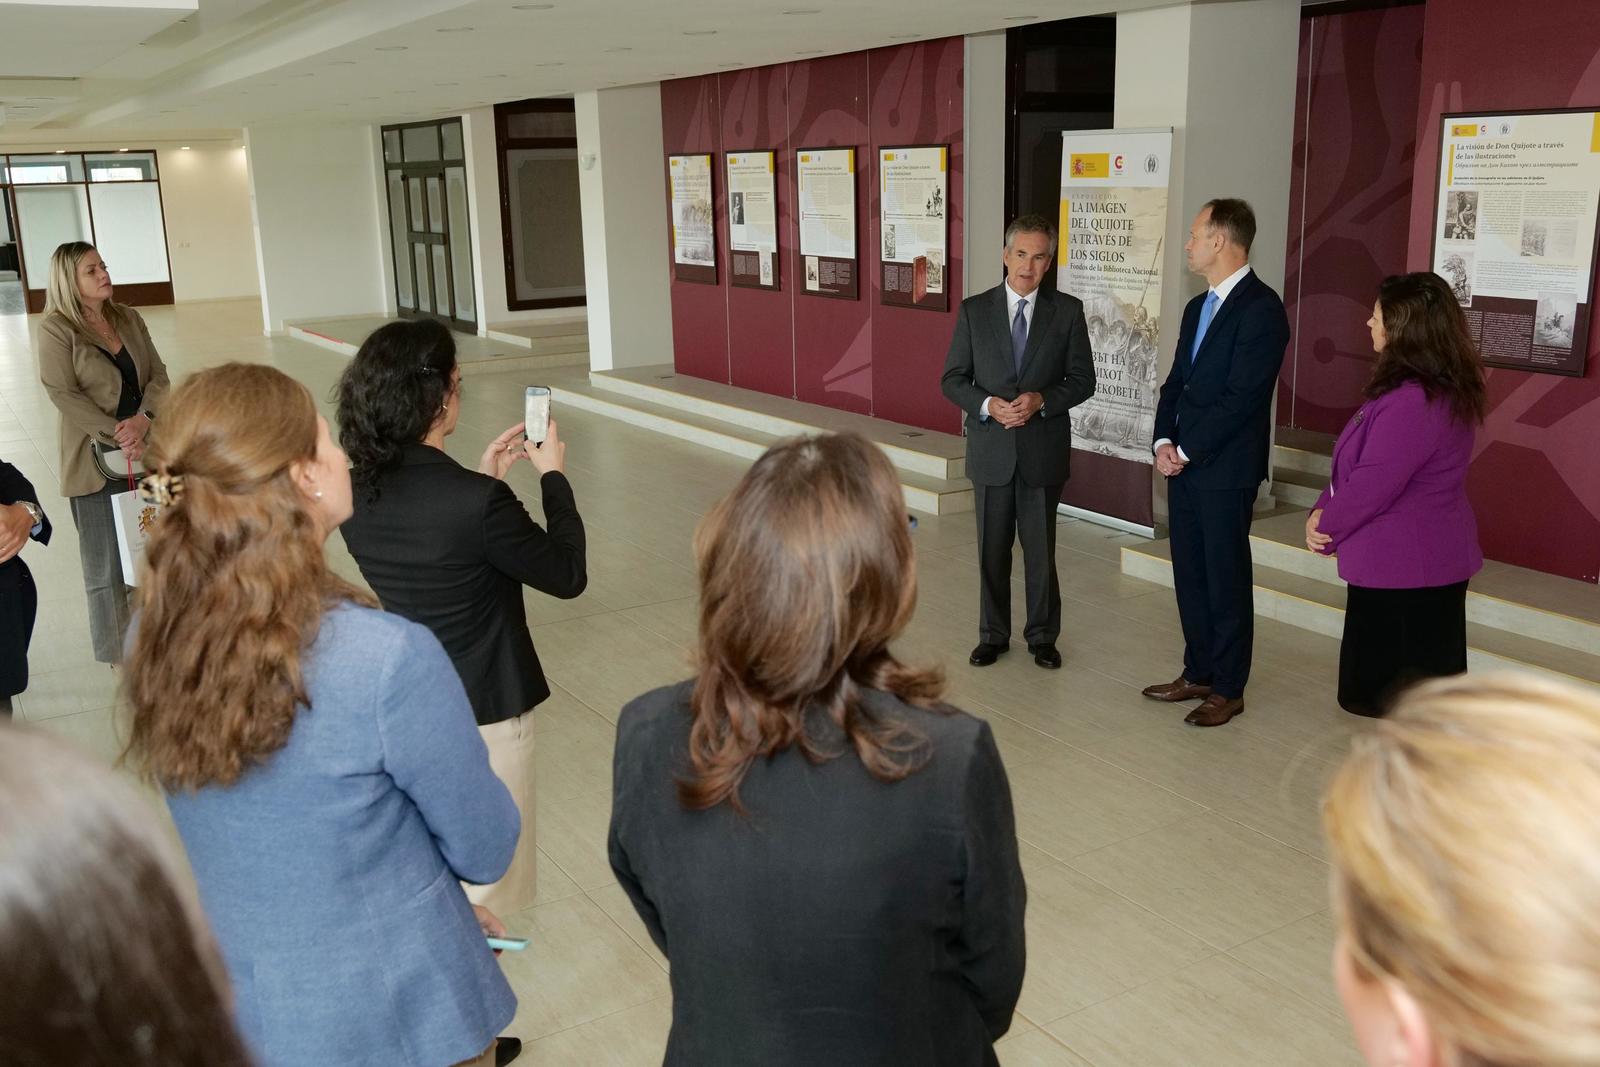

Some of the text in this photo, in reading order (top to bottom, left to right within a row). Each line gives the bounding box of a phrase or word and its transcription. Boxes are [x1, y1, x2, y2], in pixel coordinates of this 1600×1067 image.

[1511, 142, 1536, 151] Quijote
[1072, 202, 1127, 214] LA IMAGEN
[1071, 217, 1134, 232] DEL QUIJOTE
[1071, 232, 1132, 247] A TRAVÉS DE
[1070, 249, 1125, 263] LOS SIGLOS
[1070, 262, 1088, 271] Fondos
[1103, 265, 1131, 274] Biblioteca
[1132, 267, 1159, 276] Nacional
[1111, 354, 1126, 366] НА
[1096, 367, 1123, 381] ИХОТ
[1096, 383, 1141, 399] ЕКОВЕТЕ
